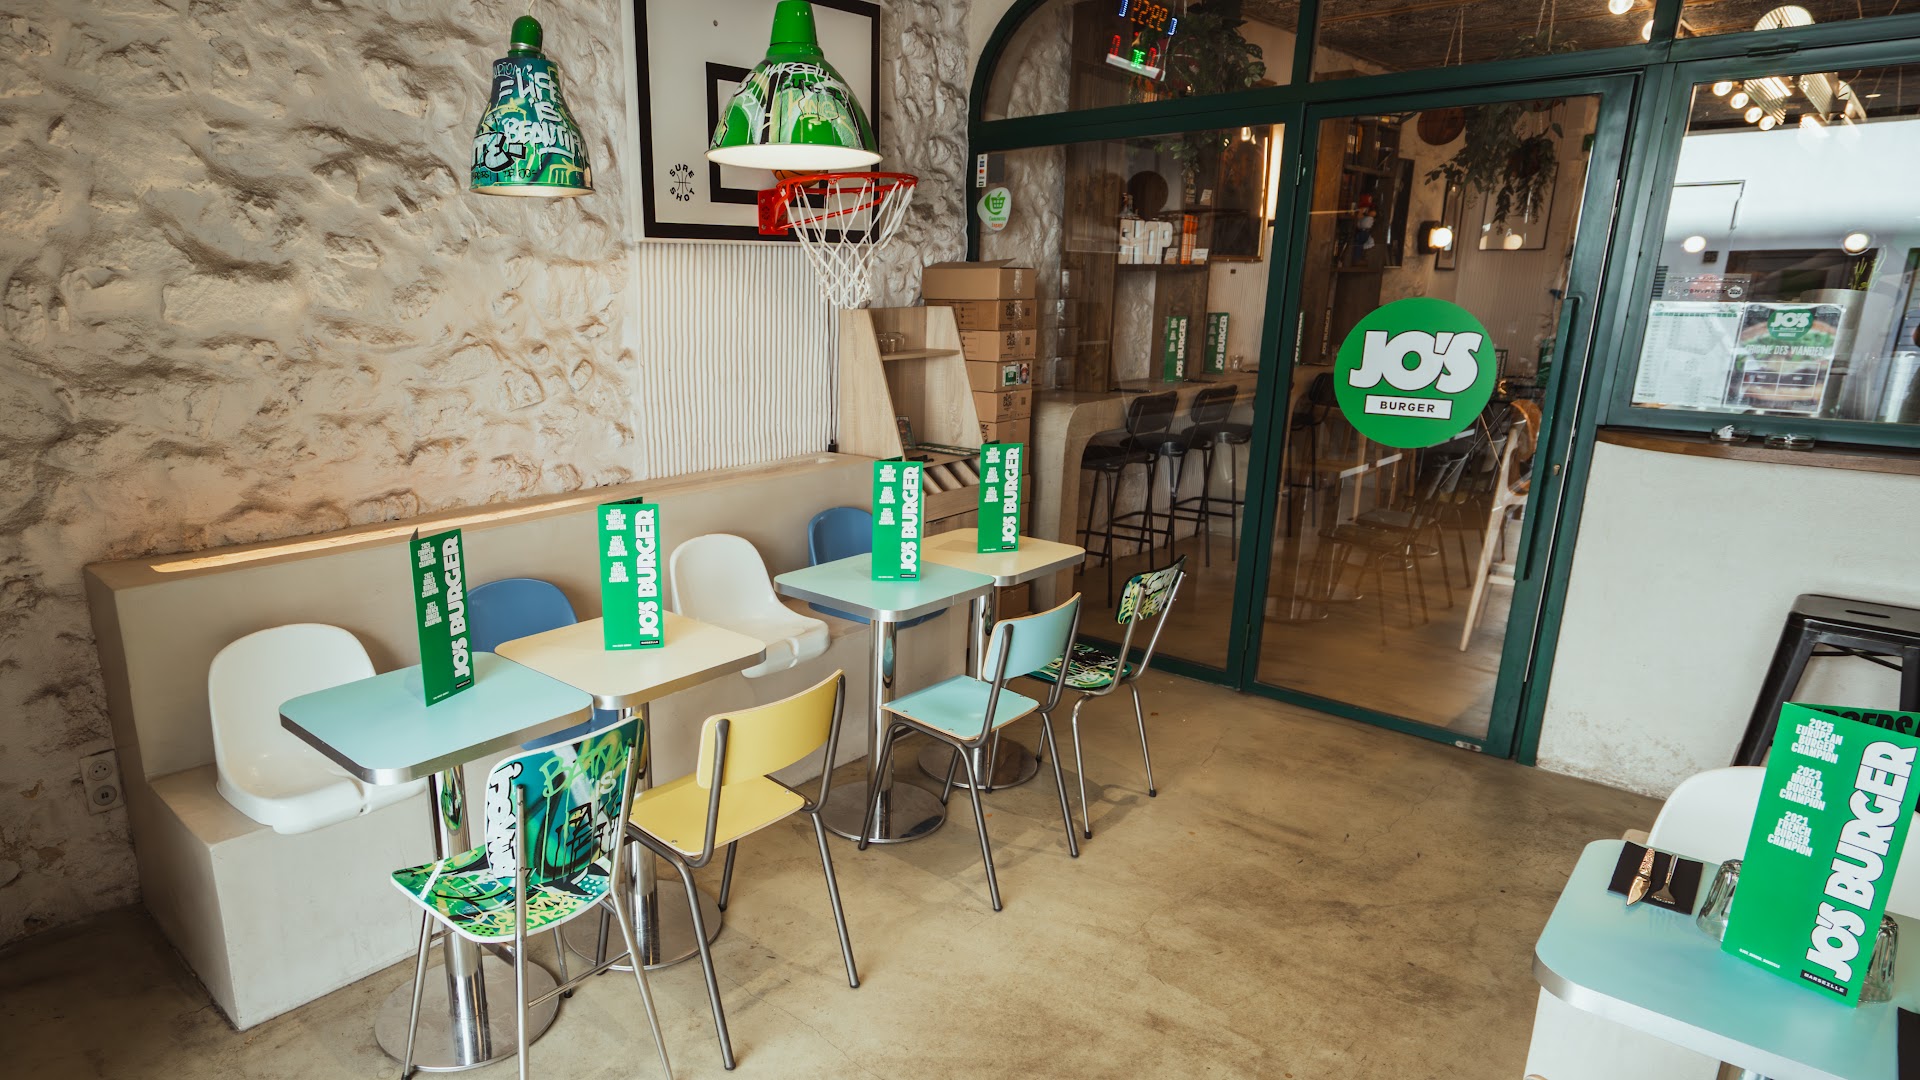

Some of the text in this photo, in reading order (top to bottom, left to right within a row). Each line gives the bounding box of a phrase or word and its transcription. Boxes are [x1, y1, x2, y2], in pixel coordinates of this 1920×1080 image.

[669, 163, 695, 179] SURE
[669, 186, 695, 202] SHOT
[1769, 311, 1811, 329] JO'S
[1774, 344, 1789, 356] DES
[1791, 344, 1825, 357] VIANDES
[1348, 329, 1484, 394] JO'S
[1379, 400, 1436, 413] BURGER
[1003, 446, 1020, 514] BURGER
[901, 465, 920, 539] BURGER
[634, 508, 659, 598] BURGER
[442, 534, 467, 637] BURGER
[637, 600, 660, 638] JO'S
[451, 635, 471, 679] JO'S
[1794, 724, 1844, 746] EUROPEAN
[1808, 717, 1835, 734] 2025
[1790, 742, 1839, 764] CHAMPION
[1797, 735, 1836, 754] BURGER
[1790, 772, 1824, 791] WORLD
[1796, 764, 1822, 780] 2023
[1778, 788, 1827, 812] CHAMPION
[1785, 780, 1824, 801] BURGER
[1777, 817, 1813, 838] FRENCH
[1784, 810, 1810, 827] 2021
[1767, 833, 1814, 858] CHAMPION
[1773, 826, 1811, 847] BURGER
[1803, 739, 1919, 984] JO'S BURGER
[1803, 971, 1845, 994] MARSEILLE
